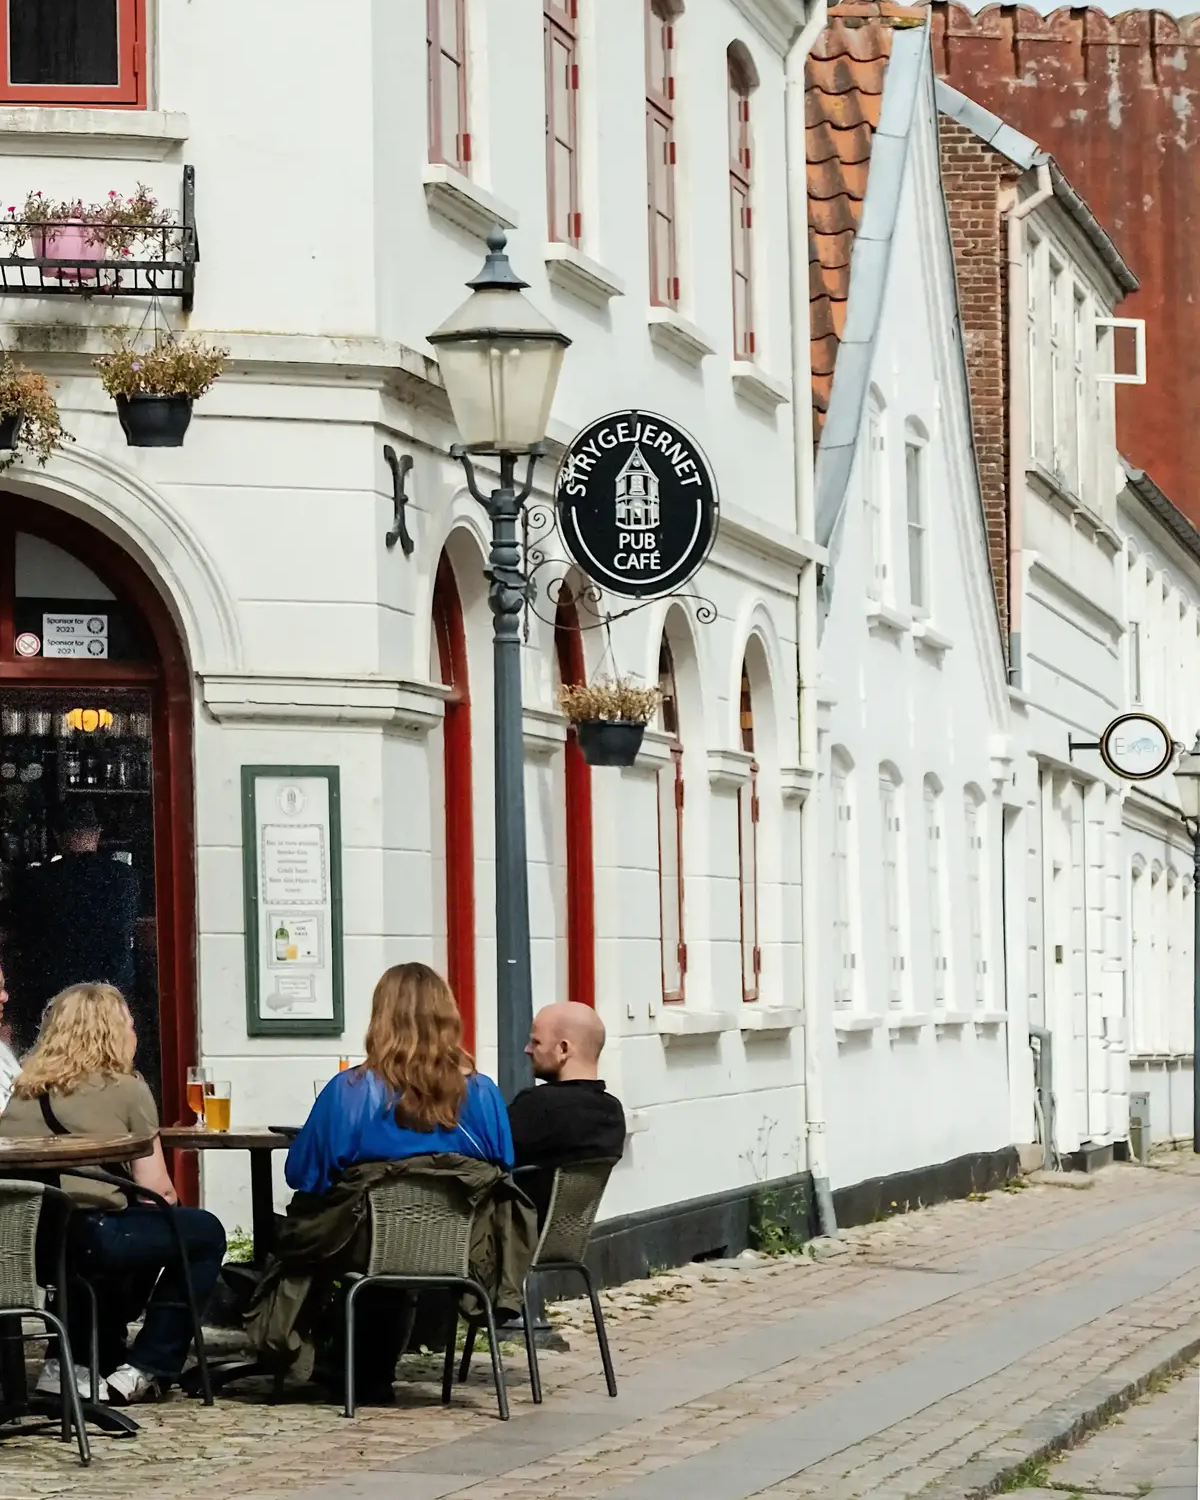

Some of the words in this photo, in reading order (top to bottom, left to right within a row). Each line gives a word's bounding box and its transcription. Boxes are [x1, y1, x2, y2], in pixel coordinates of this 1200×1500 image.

[566, 422, 702, 497] STRYGEJERNET
[618, 532, 656, 549] PUB
[613, 550, 661, 570] CAFÉ
